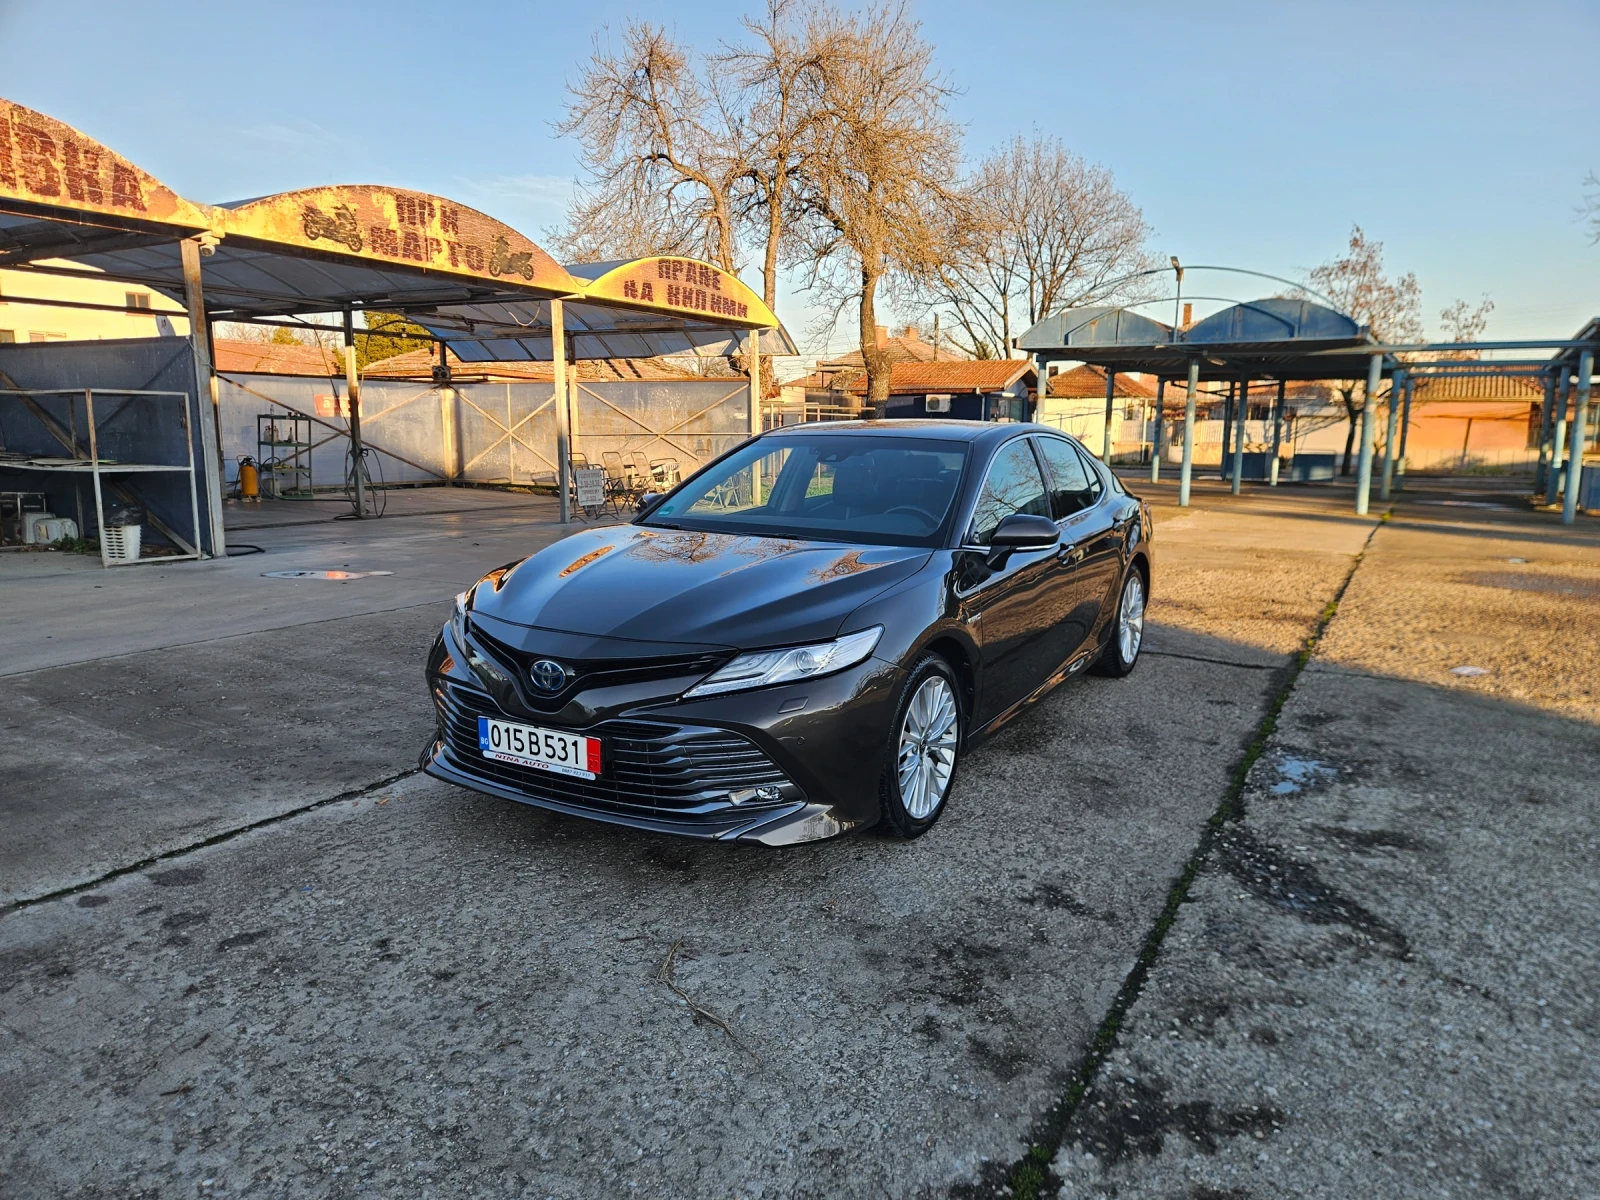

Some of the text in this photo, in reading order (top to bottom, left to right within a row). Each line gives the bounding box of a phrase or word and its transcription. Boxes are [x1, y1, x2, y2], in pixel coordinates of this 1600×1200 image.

[658, 258, 721, 291] ПРАНЕ
[624, 279, 654, 303] НА
[480, 736, 489, 746] BG
[491, 724, 579, 765] 015B531
[495, 753, 550, 769] NINA AUTO
